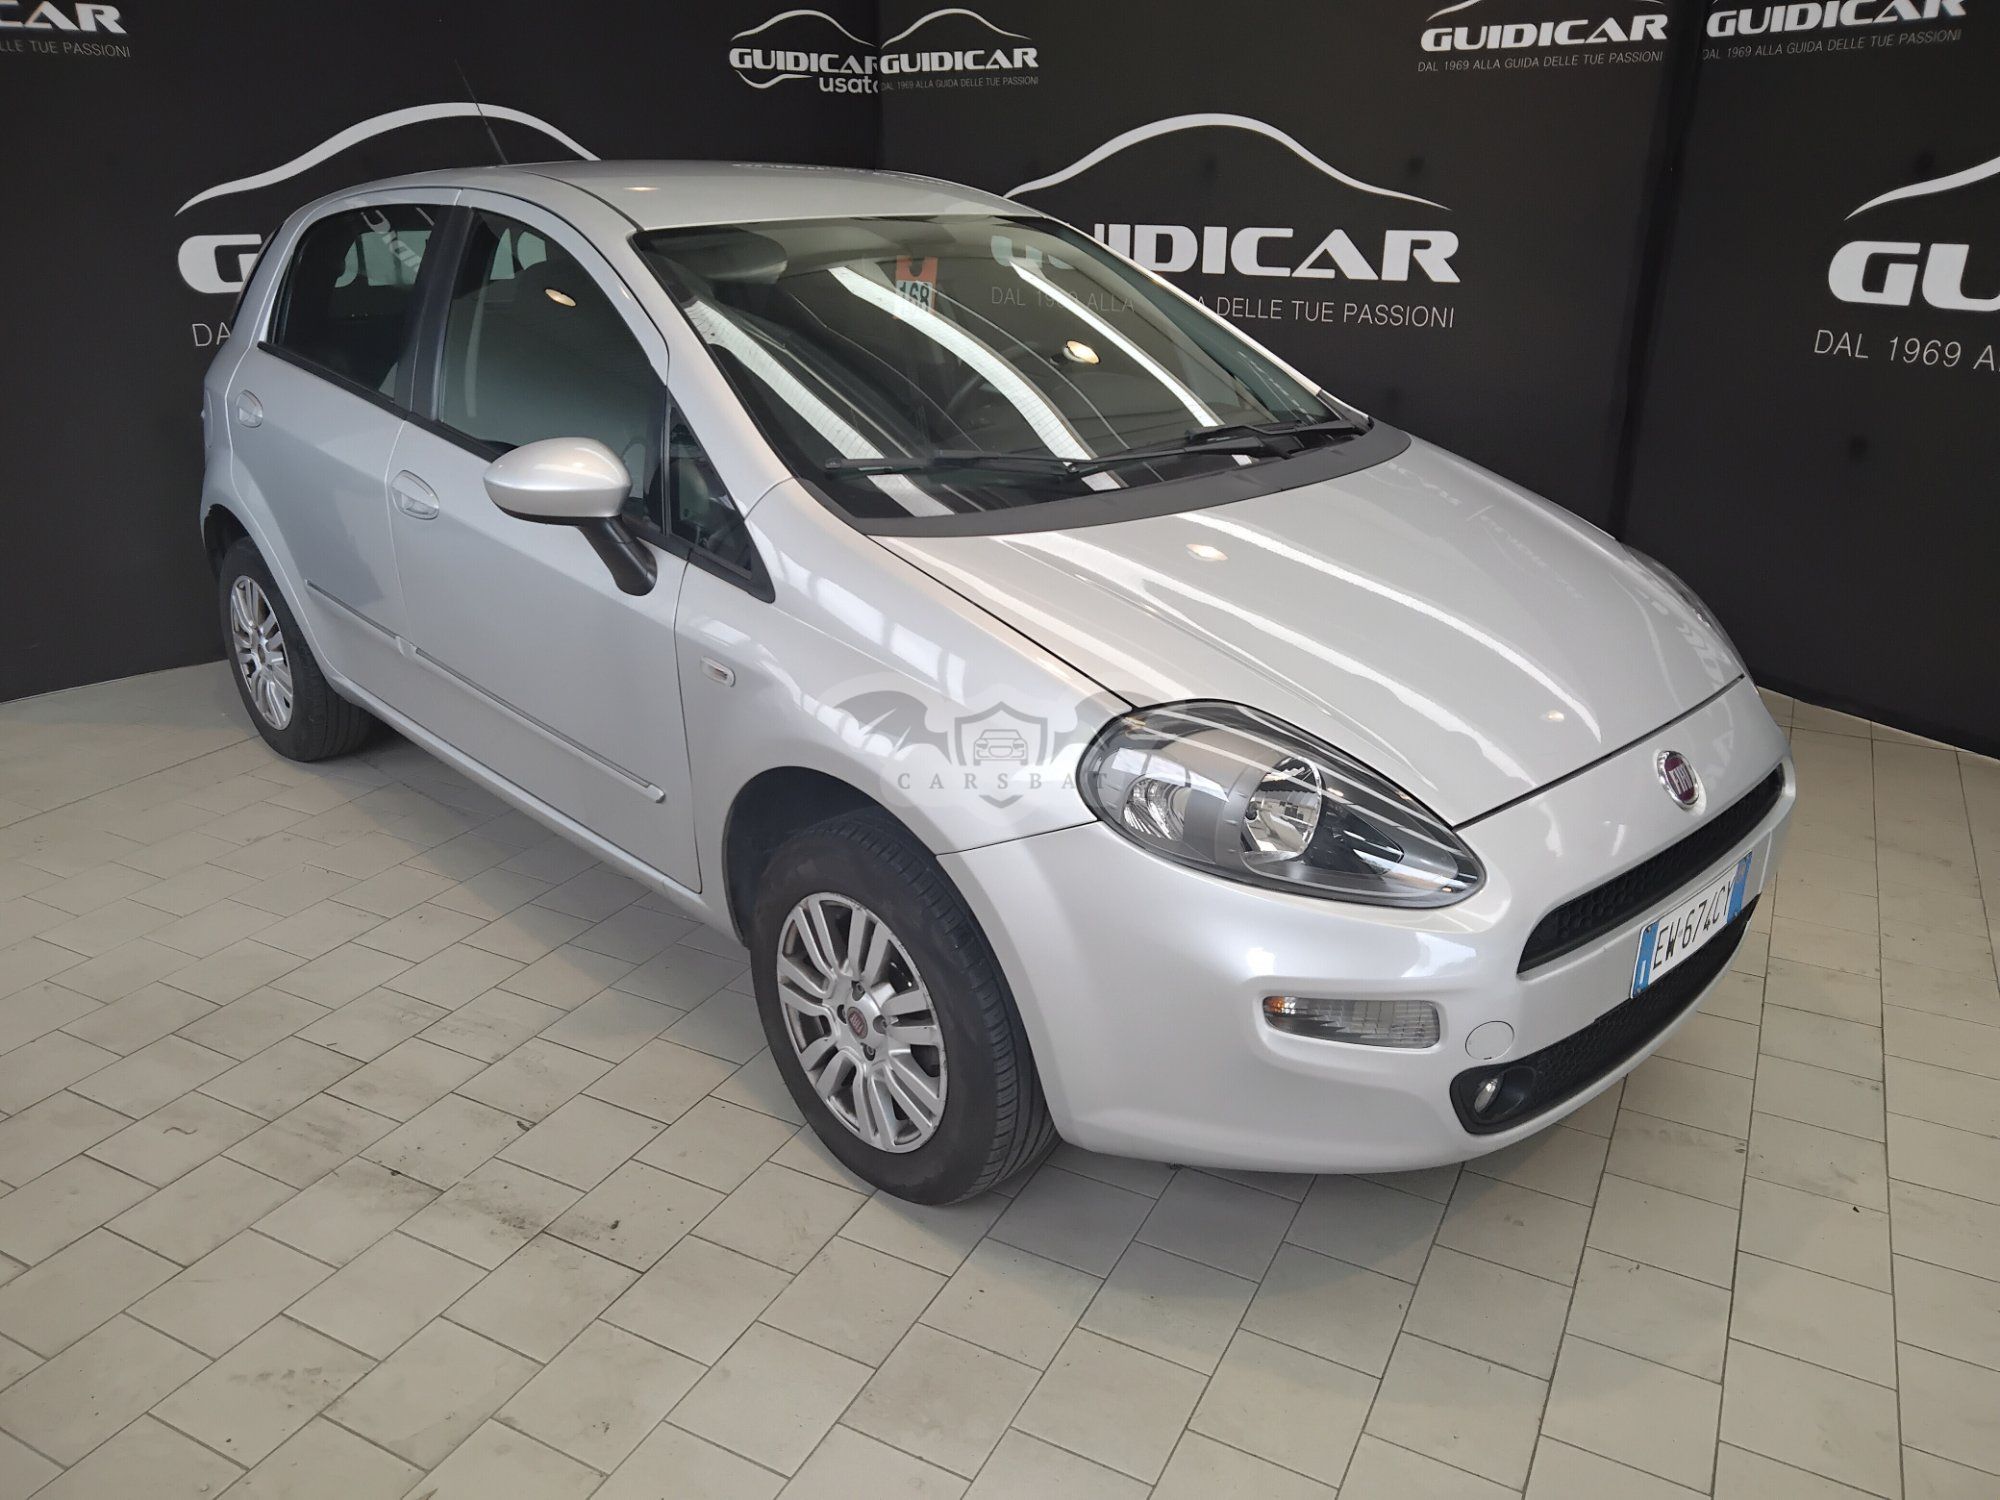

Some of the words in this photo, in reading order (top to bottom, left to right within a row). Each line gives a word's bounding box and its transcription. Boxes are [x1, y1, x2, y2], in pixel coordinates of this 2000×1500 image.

[1420, 14, 1669, 52] GUIDICAR
[1727, 46, 1751, 58] 1969
[1755, 44, 1783, 56] ALLA
[1787, 41, 1822, 54] GUIDA
[1828, 38, 1865, 51] DELLE
[1871, 35, 1894, 47] TUE
[1899, 29, 1962, 44] PASSIONI
[28, 40, 59, 54] TUE
[63, 41, 131, 58] PASSIONI
[880, 47, 1039, 74] GUIDICAR
[1418, 61, 1438, 72] DAL
[1445, 60, 1469, 71] 1969
[1473, 58, 1501, 70] ALLA
[1504, 57, 1539, 69] GUIDA
[1544, 55, 1578, 67] DELLE
[1583, 53, 1604, 65] TUE
[1608, 51, 1663, 64] PASSIONI
[915, 79, 934, 89] ALLA
[936, 78, 959, 88] GUIDA
[960, 77, 984, 87] DELLE
[986, 77, 1000, 87] TUE
[1003, 75, 1039, 86] PASSIONI
[991, 286, 1026, 306] DAL
[1217, 296, 1283, 320] DELLE
[1292, 300, 1334, 322] TUE
[1343, 302, 1455, 328] PASSIONI
[1814, 329, 1869, 359] DAL
[1889, 336, 1961, 367] 1969
